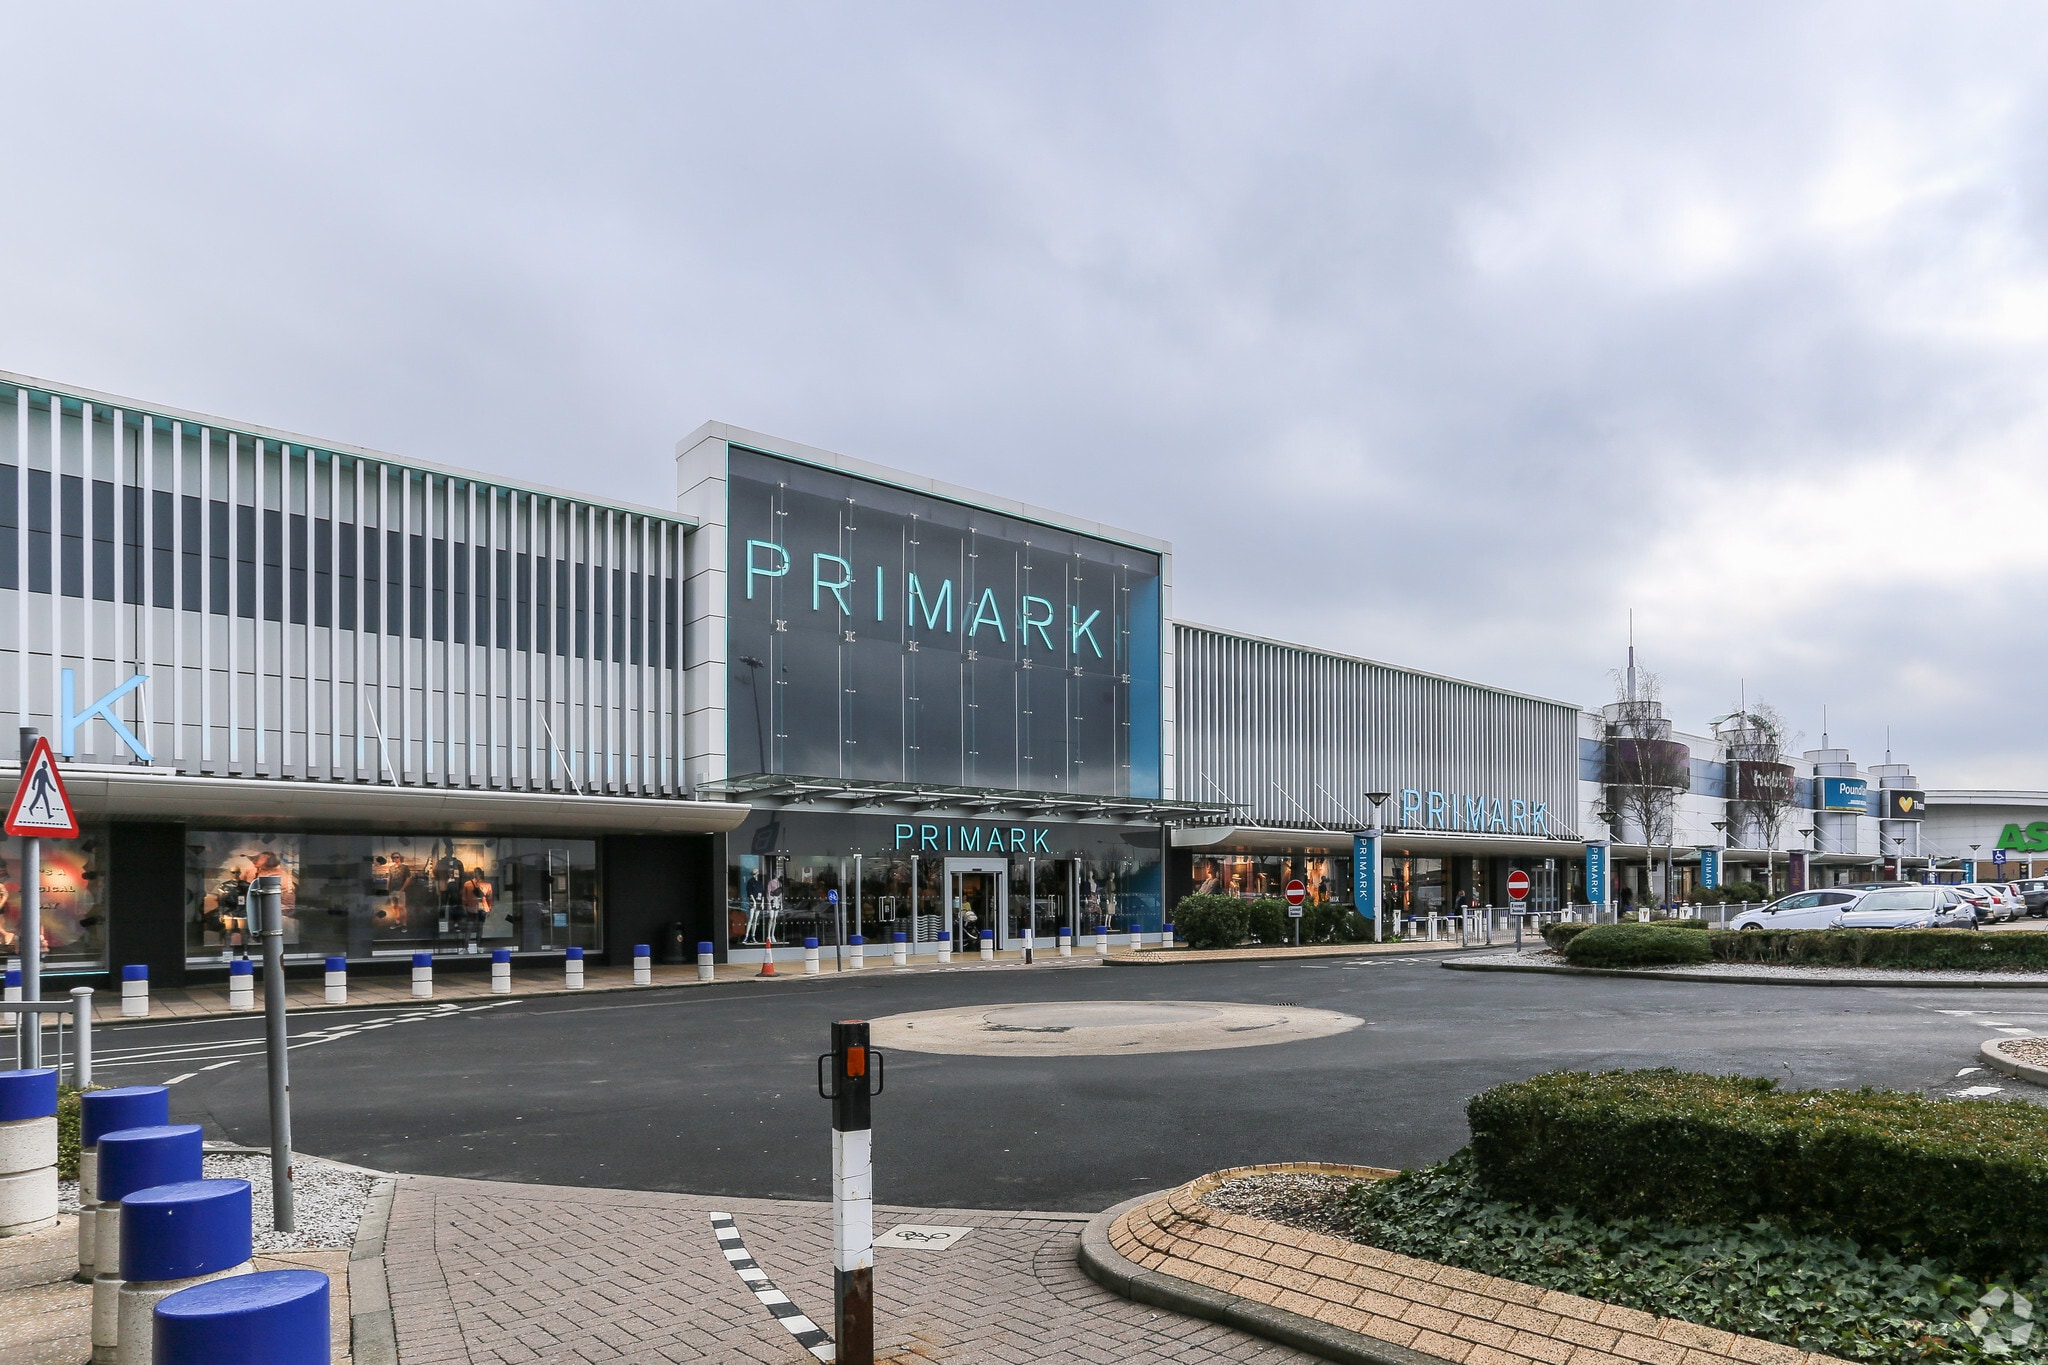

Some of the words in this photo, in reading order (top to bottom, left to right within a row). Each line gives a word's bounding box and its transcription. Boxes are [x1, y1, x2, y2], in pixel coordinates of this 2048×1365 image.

[746, 539, 1102, 658] PRIMARK
[61, 668, 155, 761] K
[1402, 788, 1549, 836] PRIMARK
[895, 823, 1050, 853] PRIMARK
[1996, 821, 2048, 853] AS
[39, 885, 76, 893] GICAL
[1359, 838, 1368, 899] PRIMARK
[1591, 847, 1599, 894] PRIMARK
